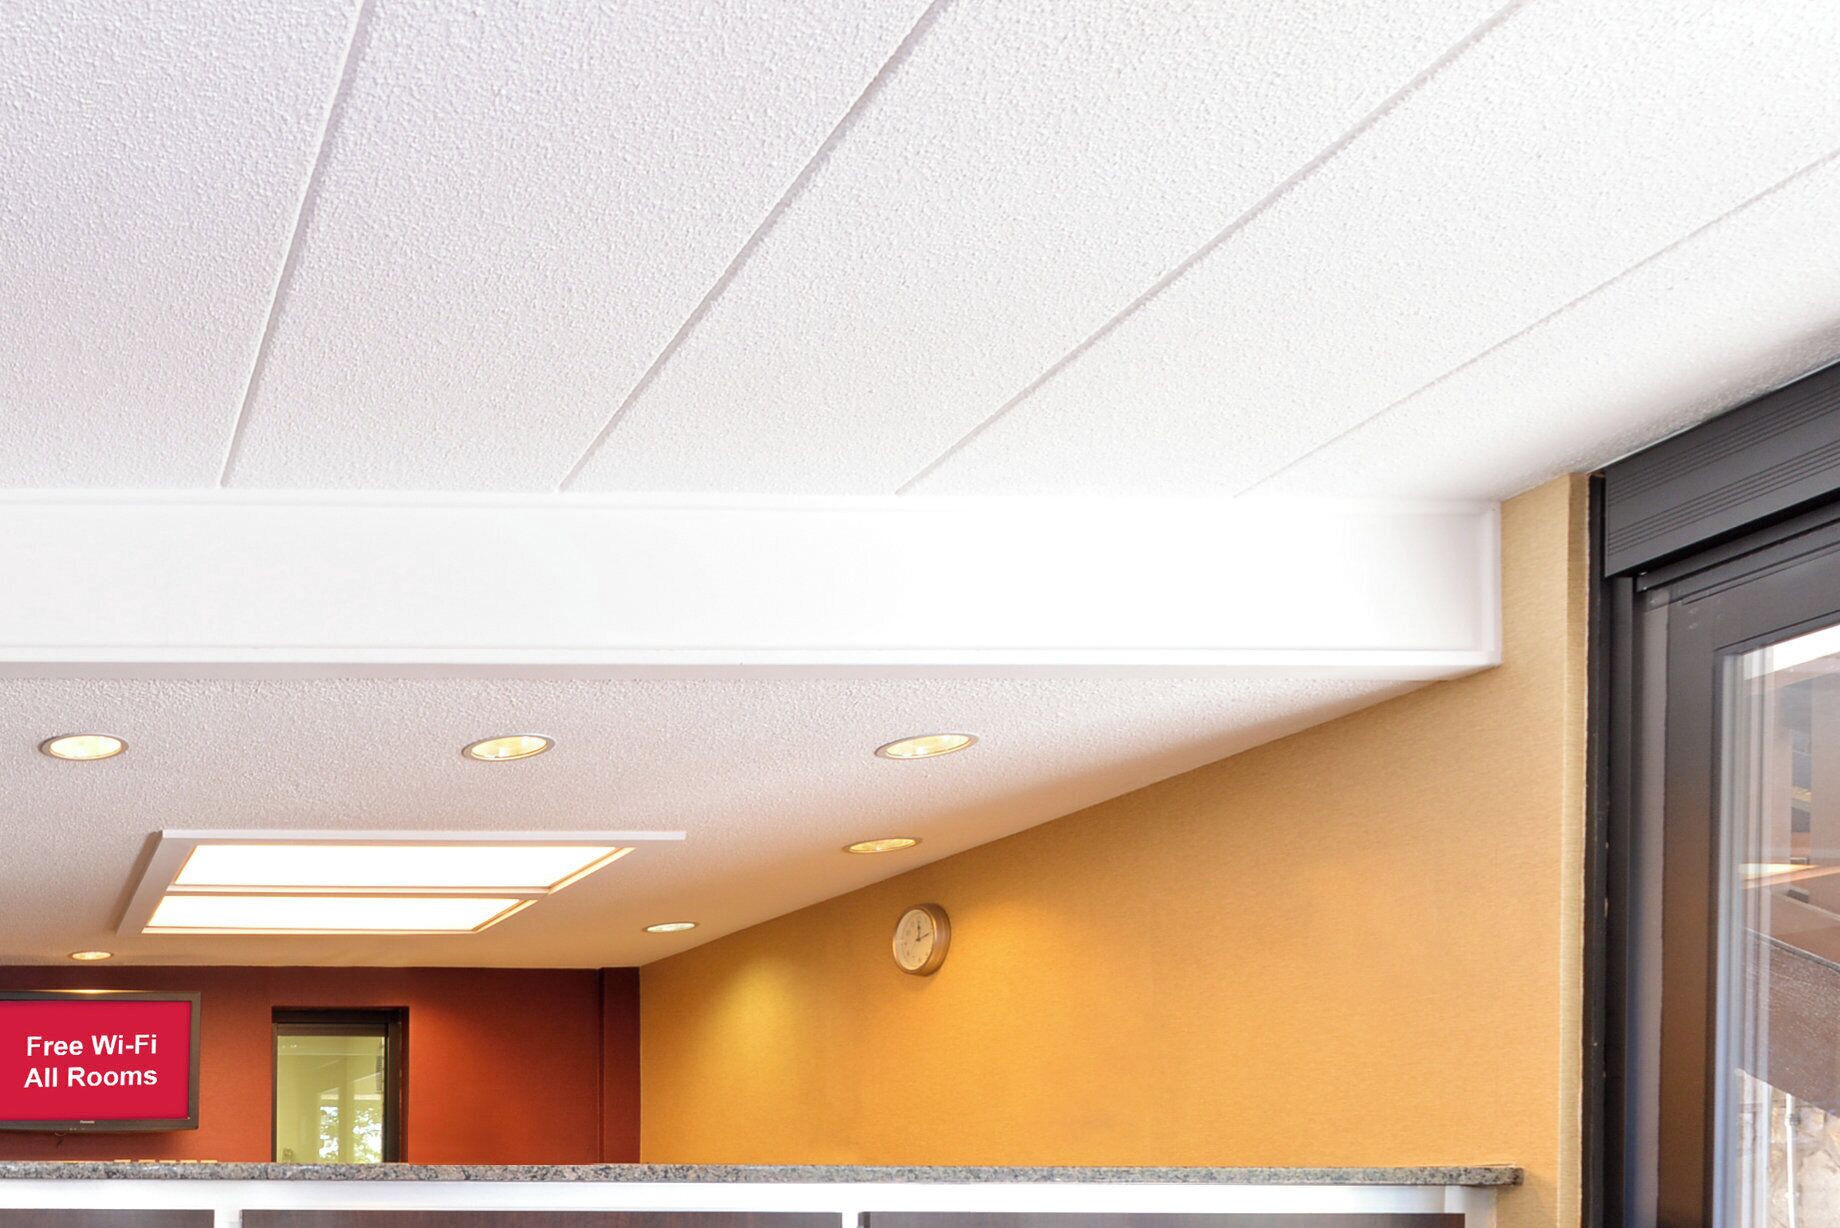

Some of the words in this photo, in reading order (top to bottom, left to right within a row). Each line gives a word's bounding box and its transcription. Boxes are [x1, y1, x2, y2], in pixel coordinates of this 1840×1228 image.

[26, 1035, 84, 1057] Free
[91, 1033, 157, 1056] Wi-Fi
[23, 1067, 58, 1088] All
[67, 1066, 158, 1088] Rooms
